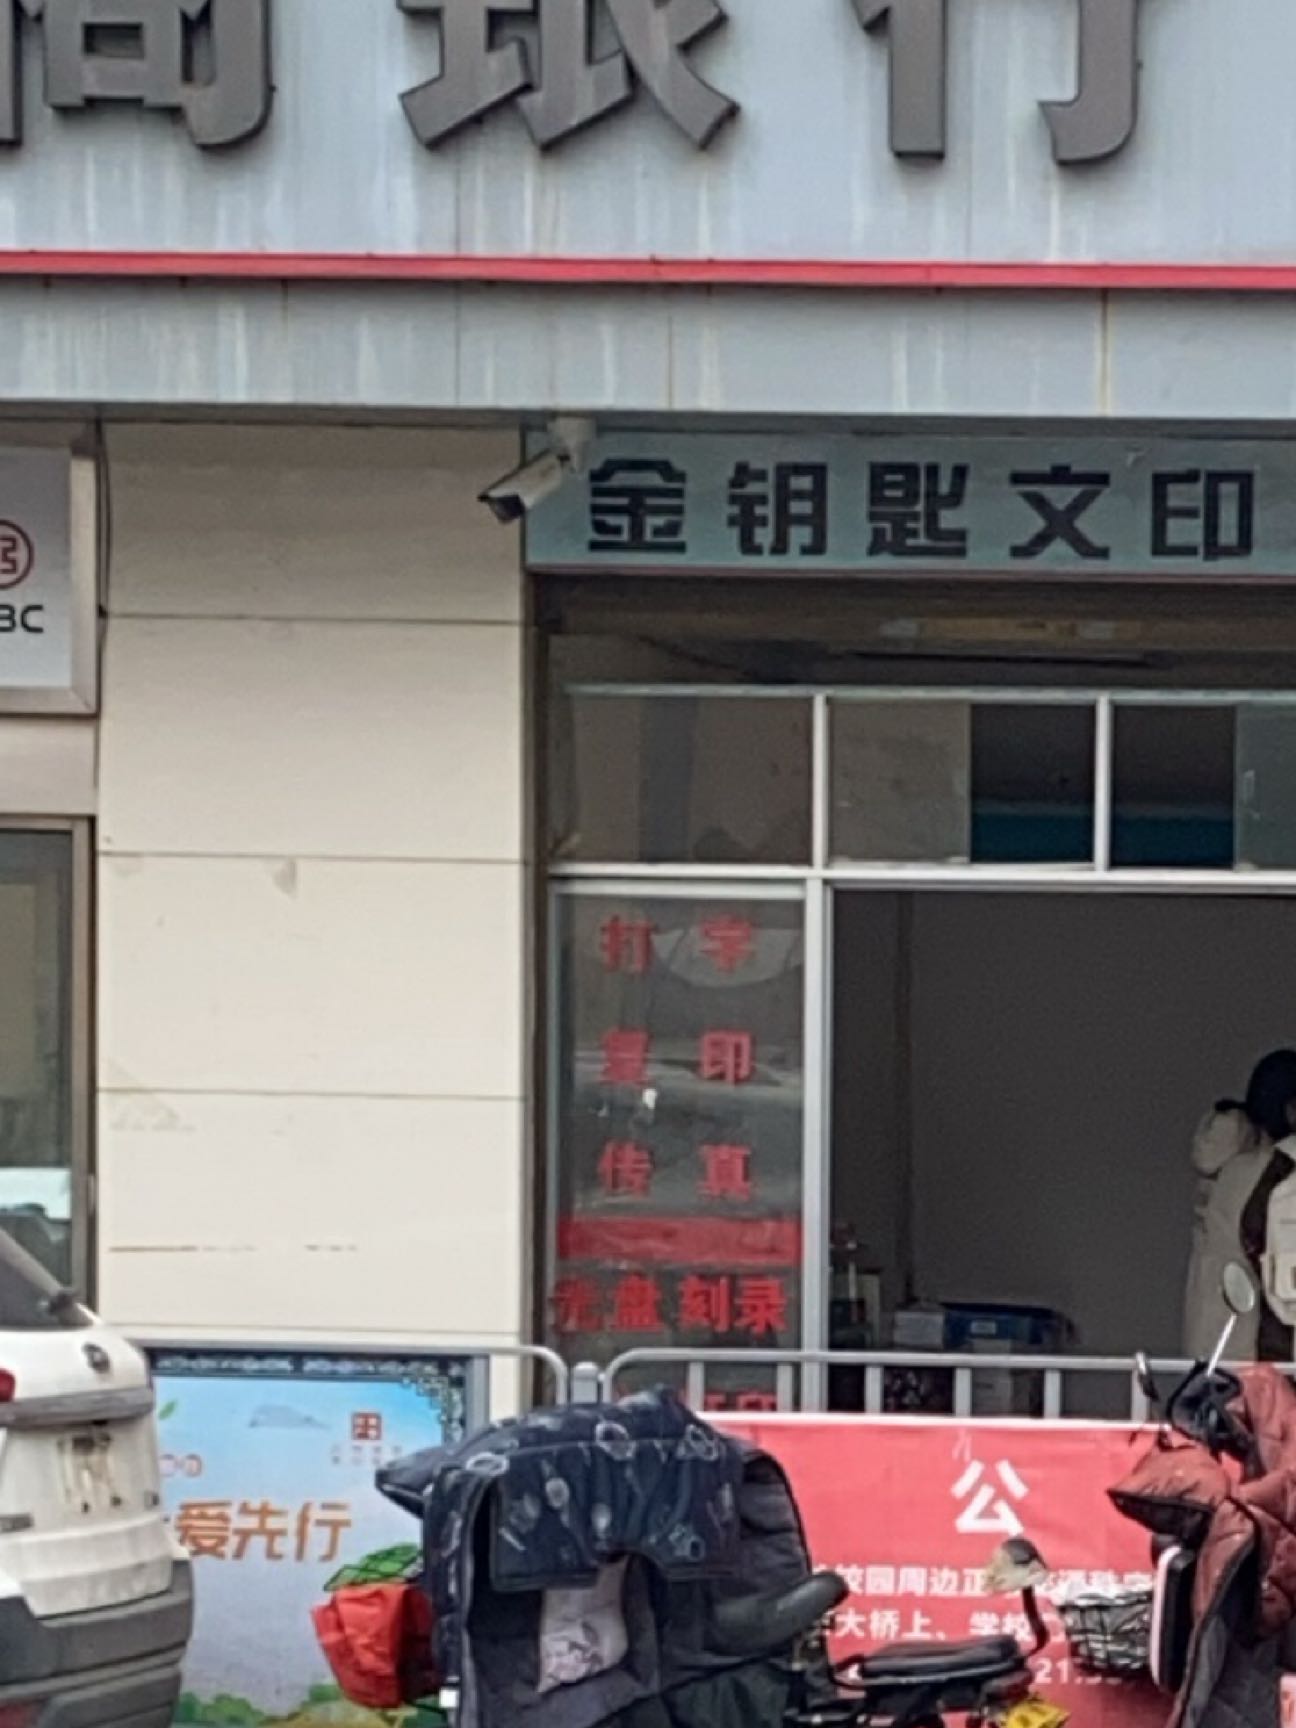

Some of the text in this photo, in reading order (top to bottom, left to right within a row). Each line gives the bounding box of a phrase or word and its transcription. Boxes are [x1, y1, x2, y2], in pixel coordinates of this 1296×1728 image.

[588, 459, 1254, 560] 金钥匙文印
[951, 1459, 1030, 1535] 公
